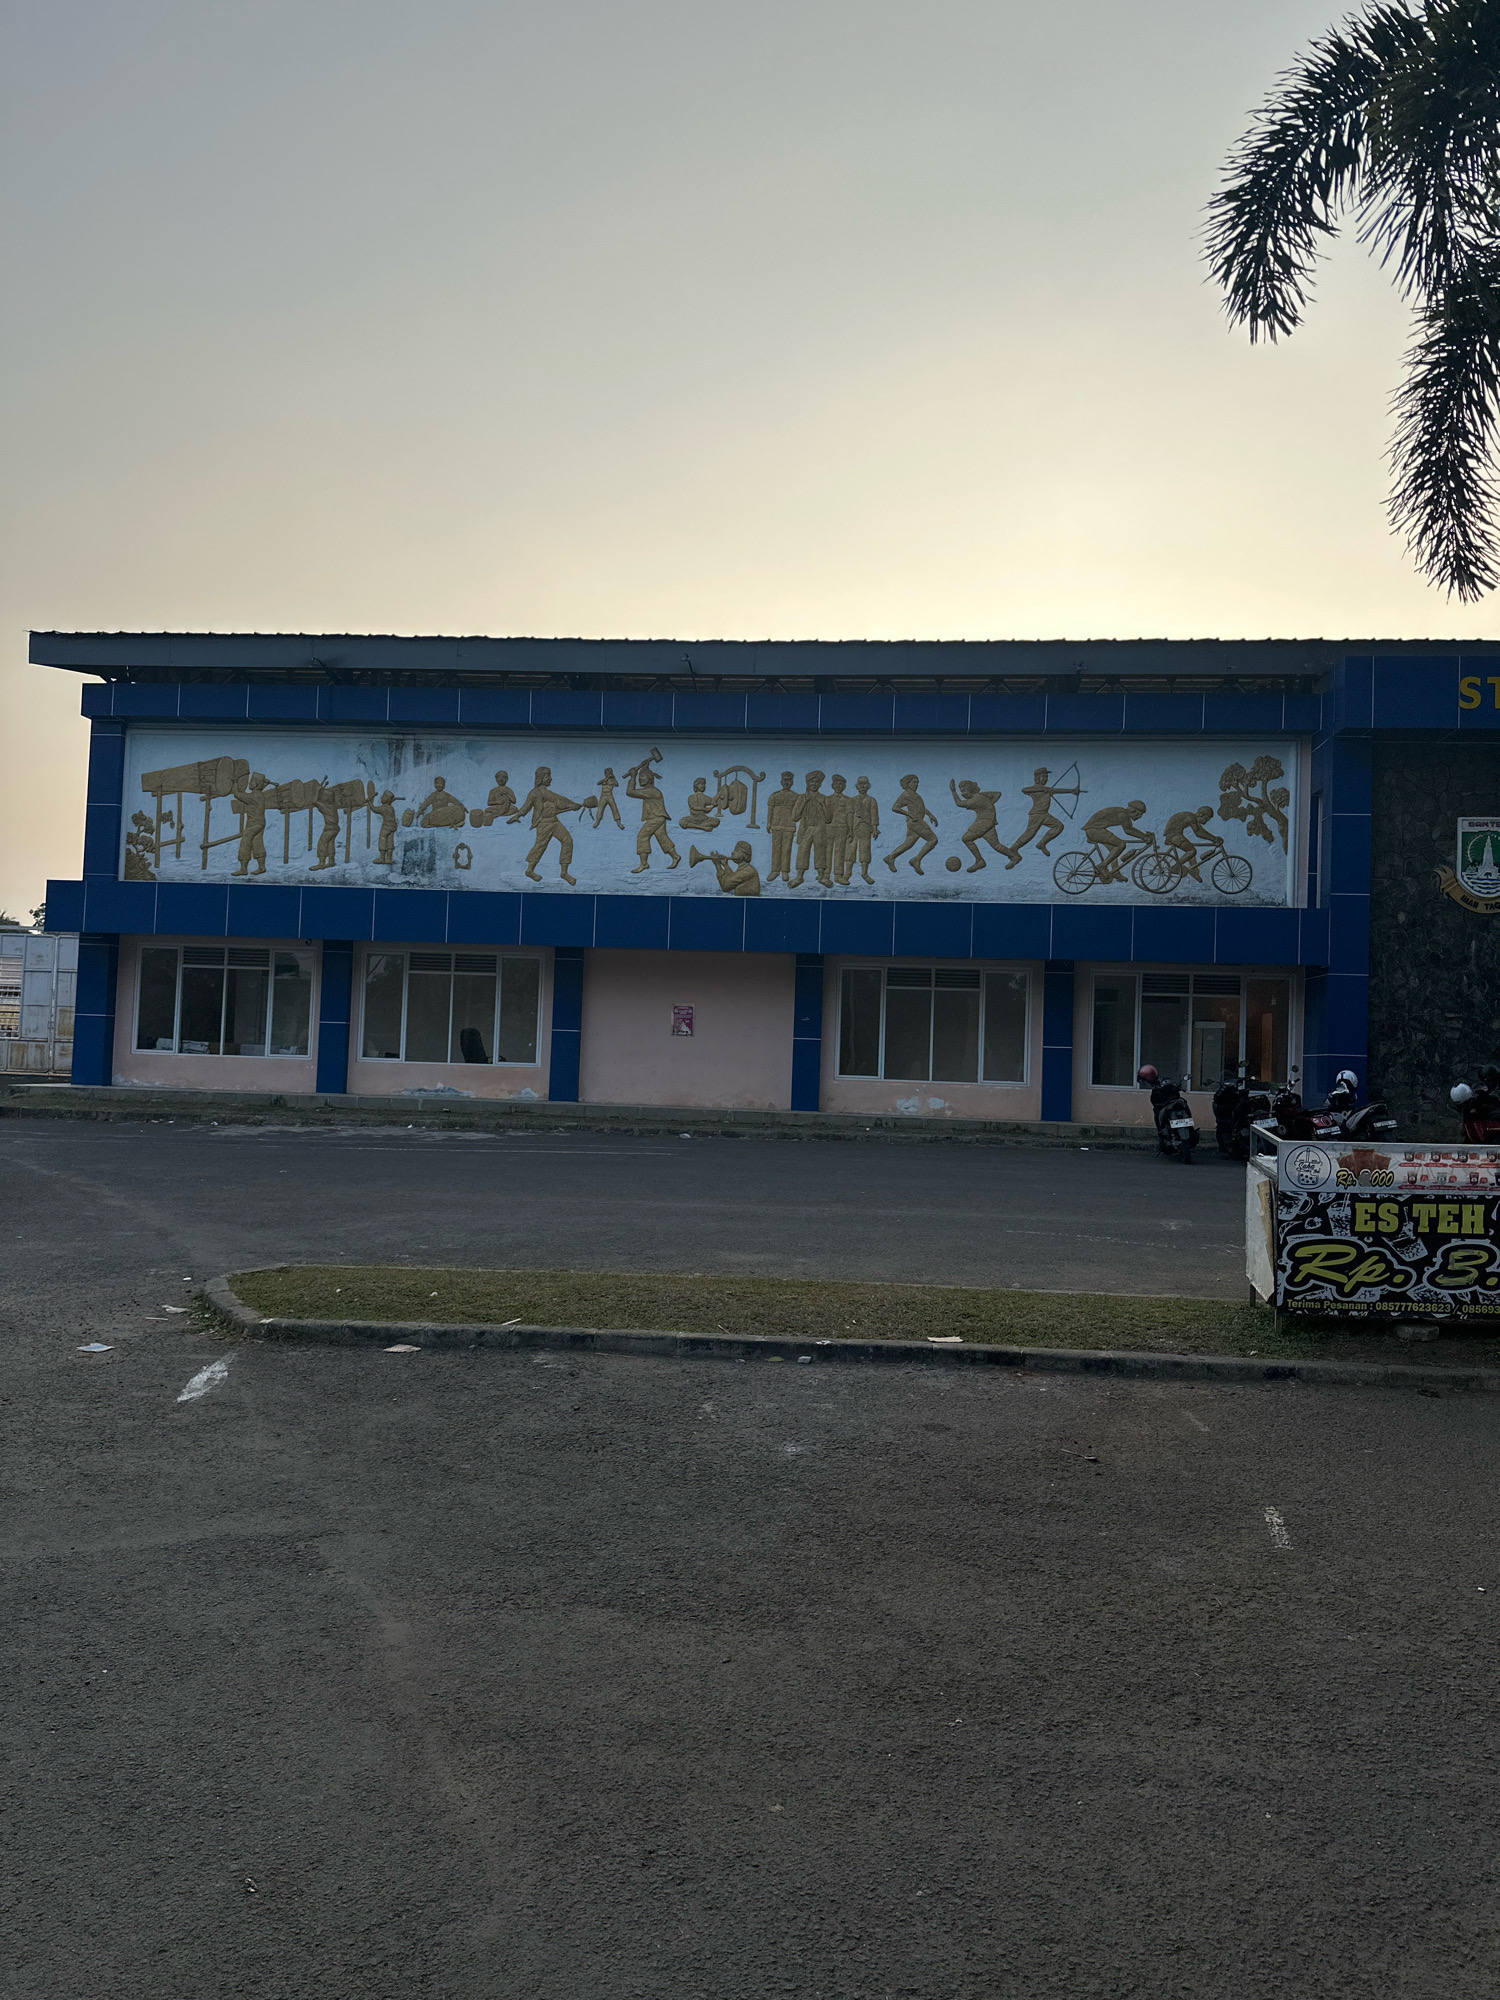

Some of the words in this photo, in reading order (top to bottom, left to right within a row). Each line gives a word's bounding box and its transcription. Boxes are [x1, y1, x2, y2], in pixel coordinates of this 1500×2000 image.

[1354, 1202, 1399, 1233] ES
[1412, 1203, 1485, 1234] TEH
[1294, 1244, 1404, 1292] Rp.
[1287, 1299, 1321, 1309] Terima
[1323, 1301, 1367, 1311] Pesanan
[1375, 1302, 1451, 1312] 085777623623
[1462, 1304, 1500, 1315] 085693
